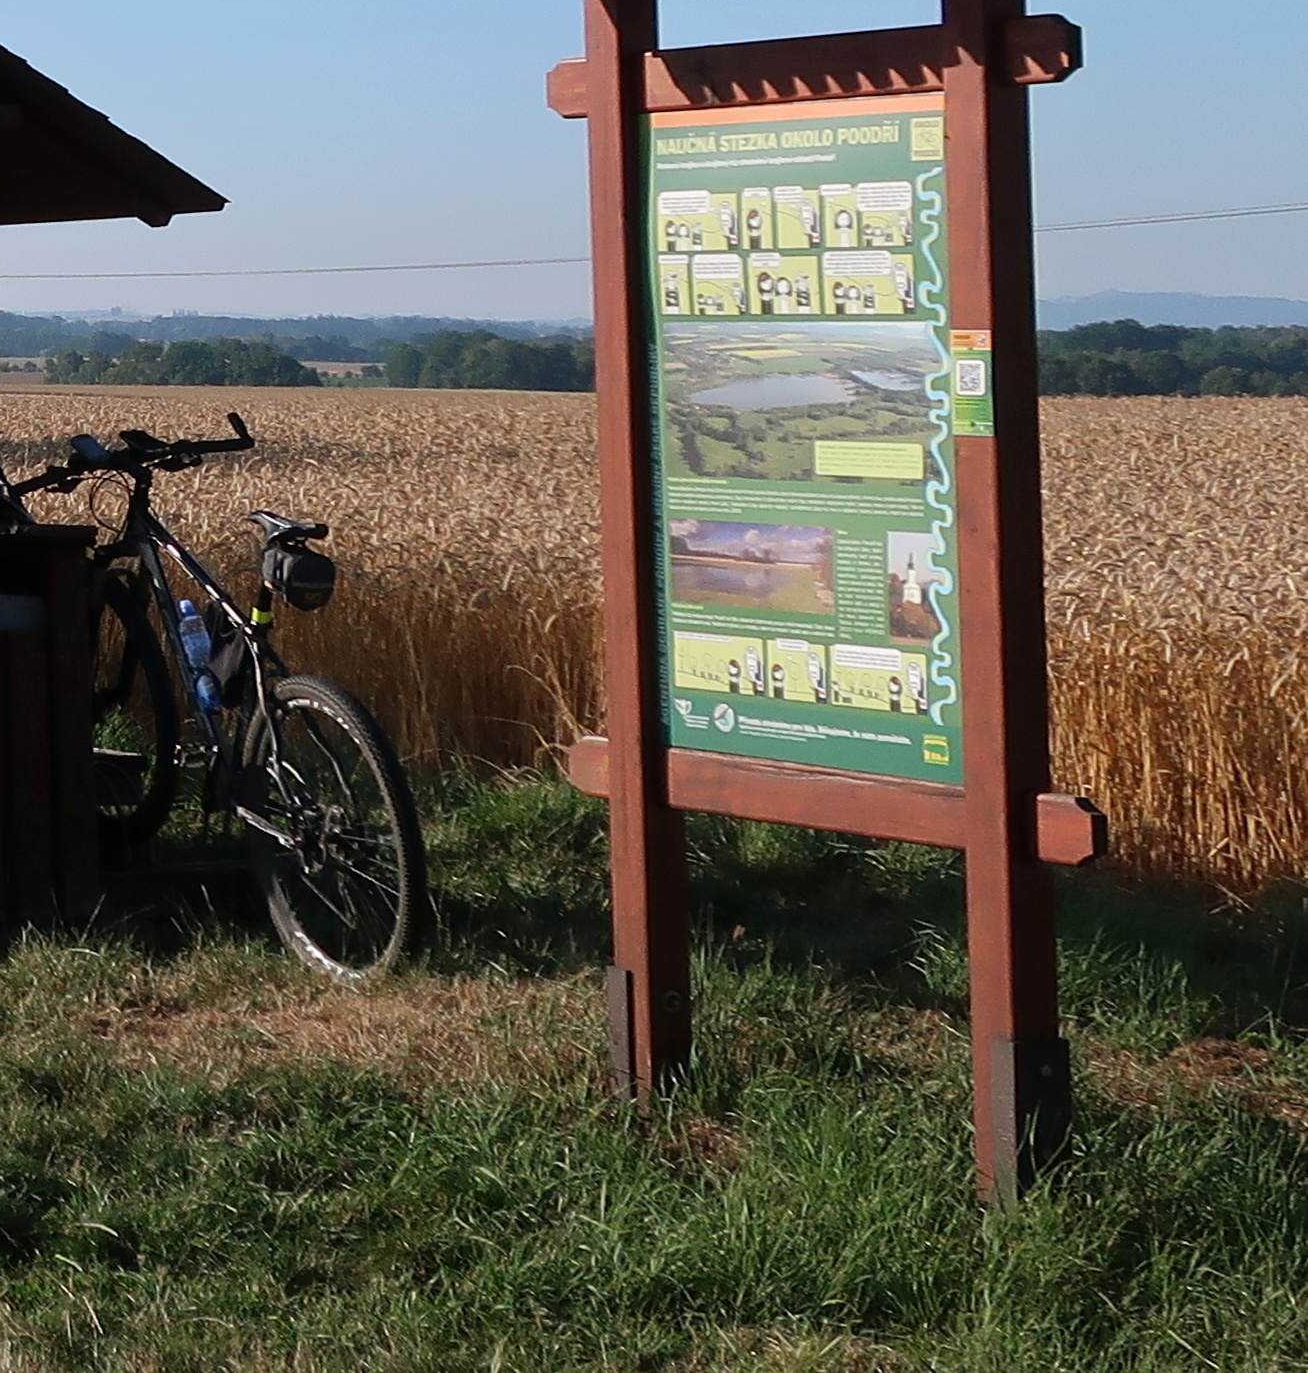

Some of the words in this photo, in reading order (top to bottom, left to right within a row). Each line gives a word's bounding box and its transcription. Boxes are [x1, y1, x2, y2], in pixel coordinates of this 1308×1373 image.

[656, 132, 717, 156] NAUČNÁ
[719, 133, 778, 152] STEZKA
[781, 129, 833, 148] OKOLO
[837, 120, 900, 145] POODŘÍ
